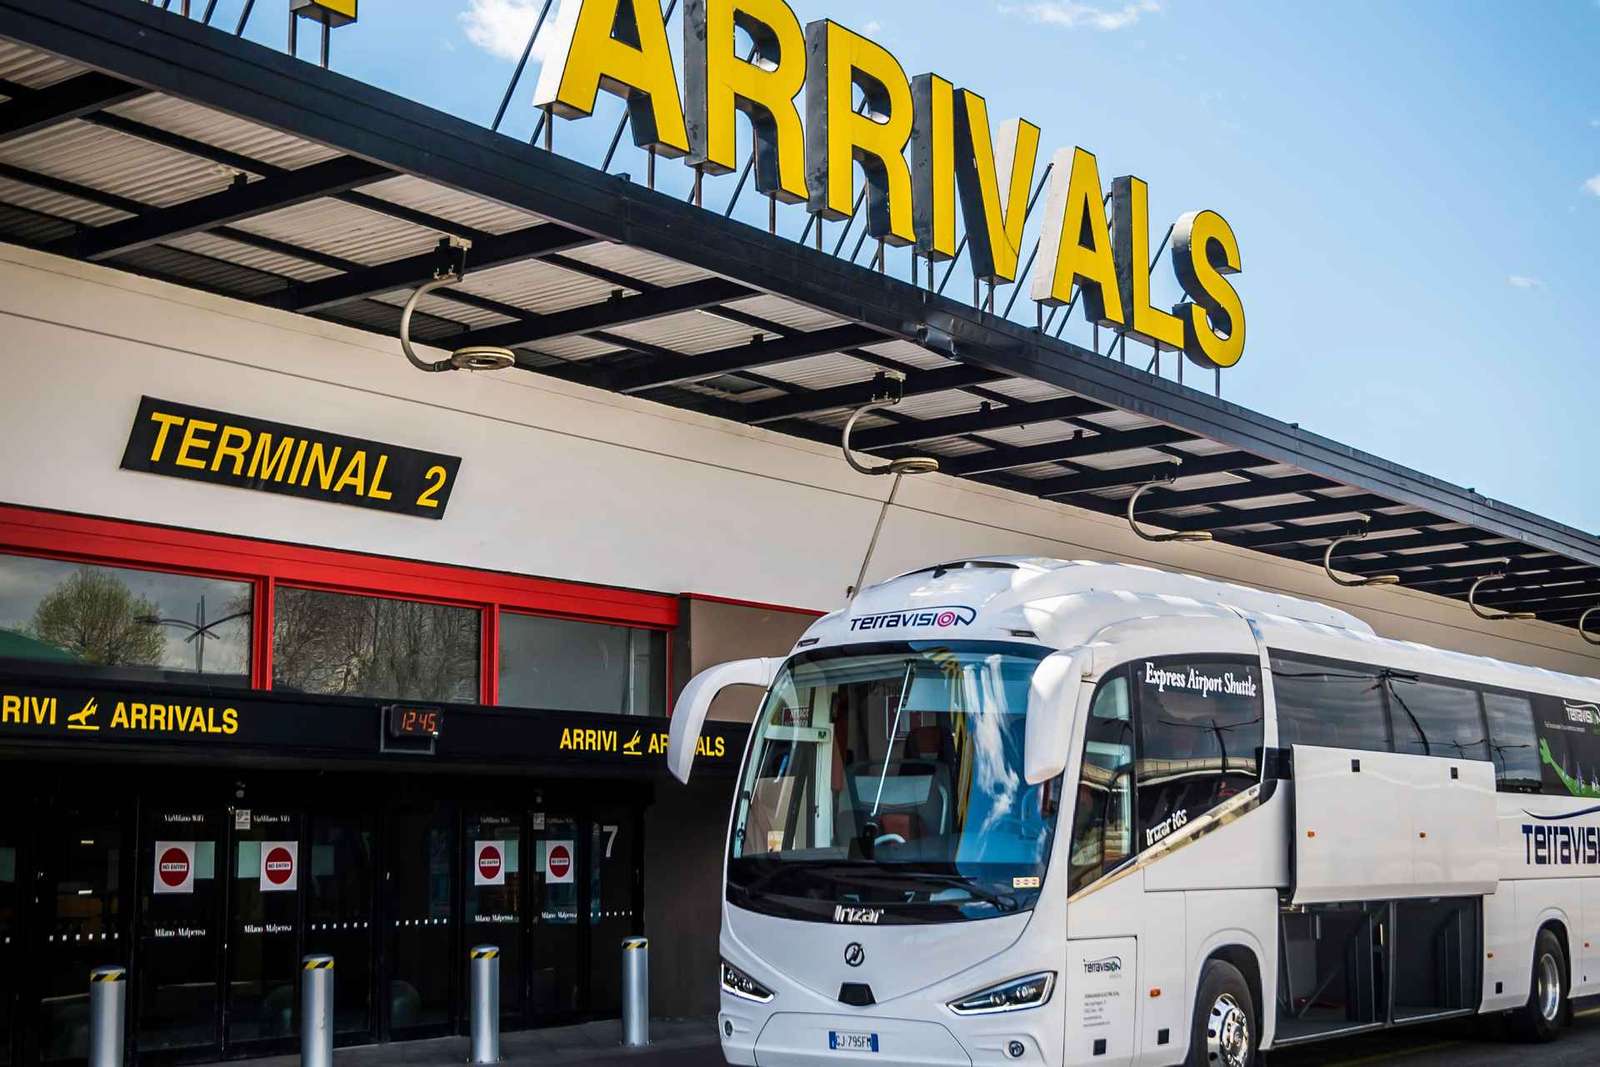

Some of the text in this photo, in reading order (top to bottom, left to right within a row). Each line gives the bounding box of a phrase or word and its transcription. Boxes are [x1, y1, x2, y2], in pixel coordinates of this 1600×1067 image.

[537, 0, 1246, 368] ARRIVALS
[150, 411, 447, 508] TERMINAL 2
[1145, 661, 1257, 698] Express Airport Shuttle
[2, 695, 239, 735] RIVI ARRIVALS
[560, 728, 725, 757] ARRIVI ARALS
[603, 825, 618, 858] 7
[154, 927, 206, 938] Milano Malpensa
[244, 923, 292, 934] Milano Malpensa
